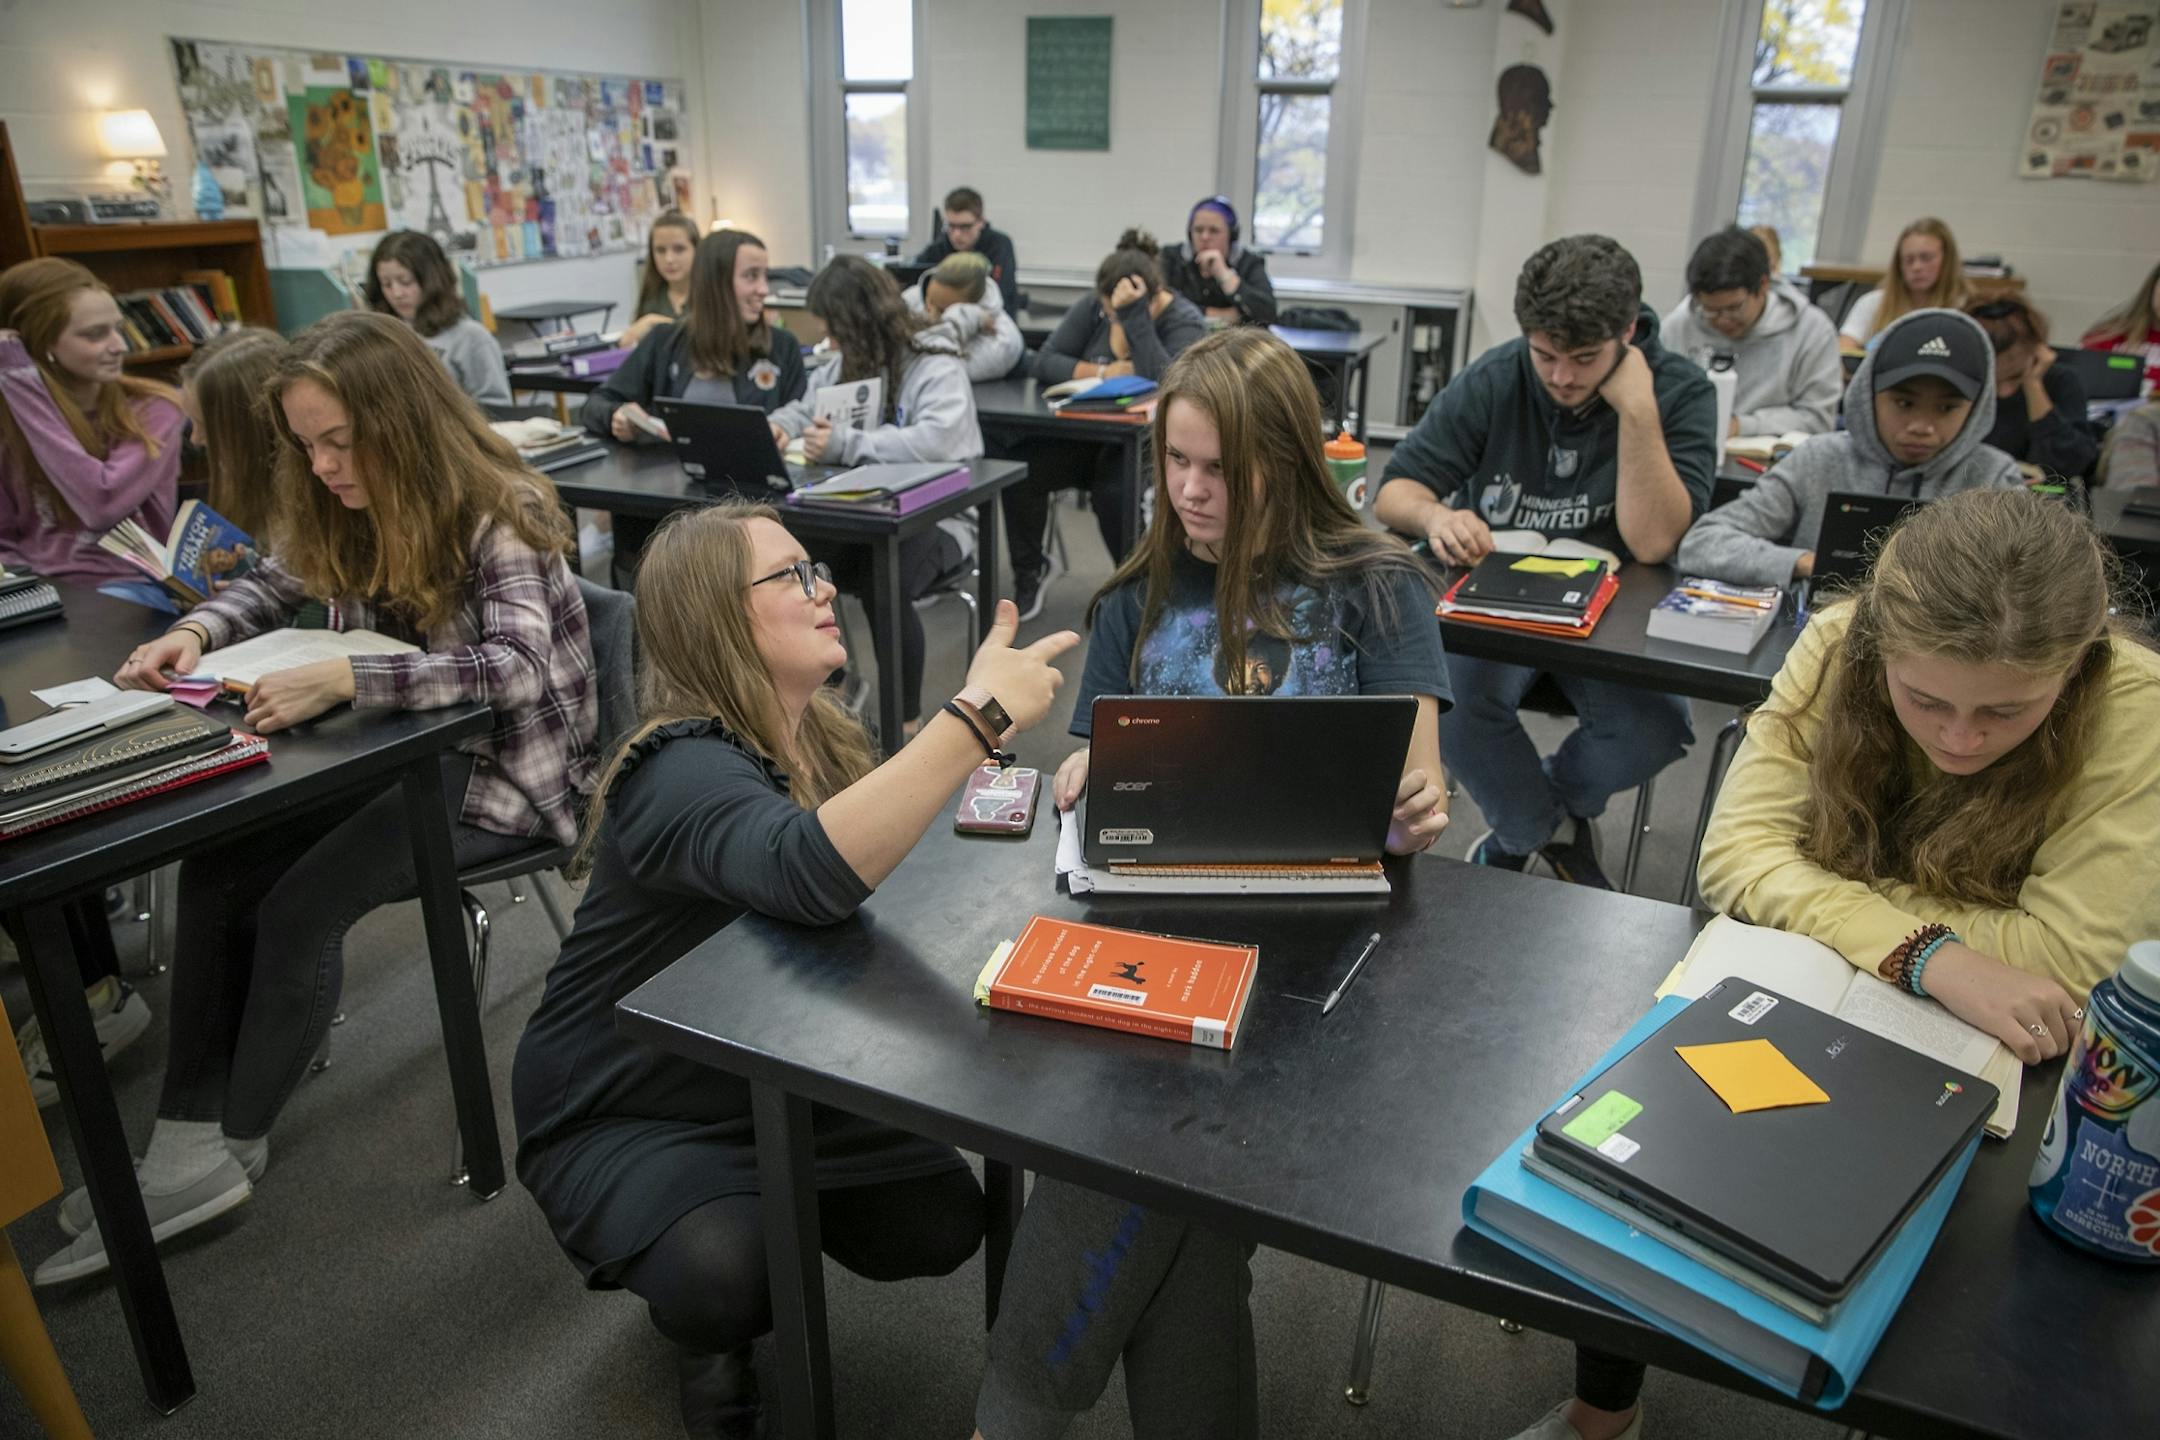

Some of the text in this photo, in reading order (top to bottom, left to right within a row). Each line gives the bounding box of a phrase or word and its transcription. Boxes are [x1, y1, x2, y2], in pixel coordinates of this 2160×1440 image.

[1514, 507, 1590, 529] UNITED
[178, 512, 207, 571] TREVOR
[185, 525, 210, 570] NOAH
[1132, 717, 1160, 725] chrome
[1113, 782, 1152, 791] acer
[1181, 984, 1193, 1002] mark
[2080, 1138, 2159, 1187] NORTH
